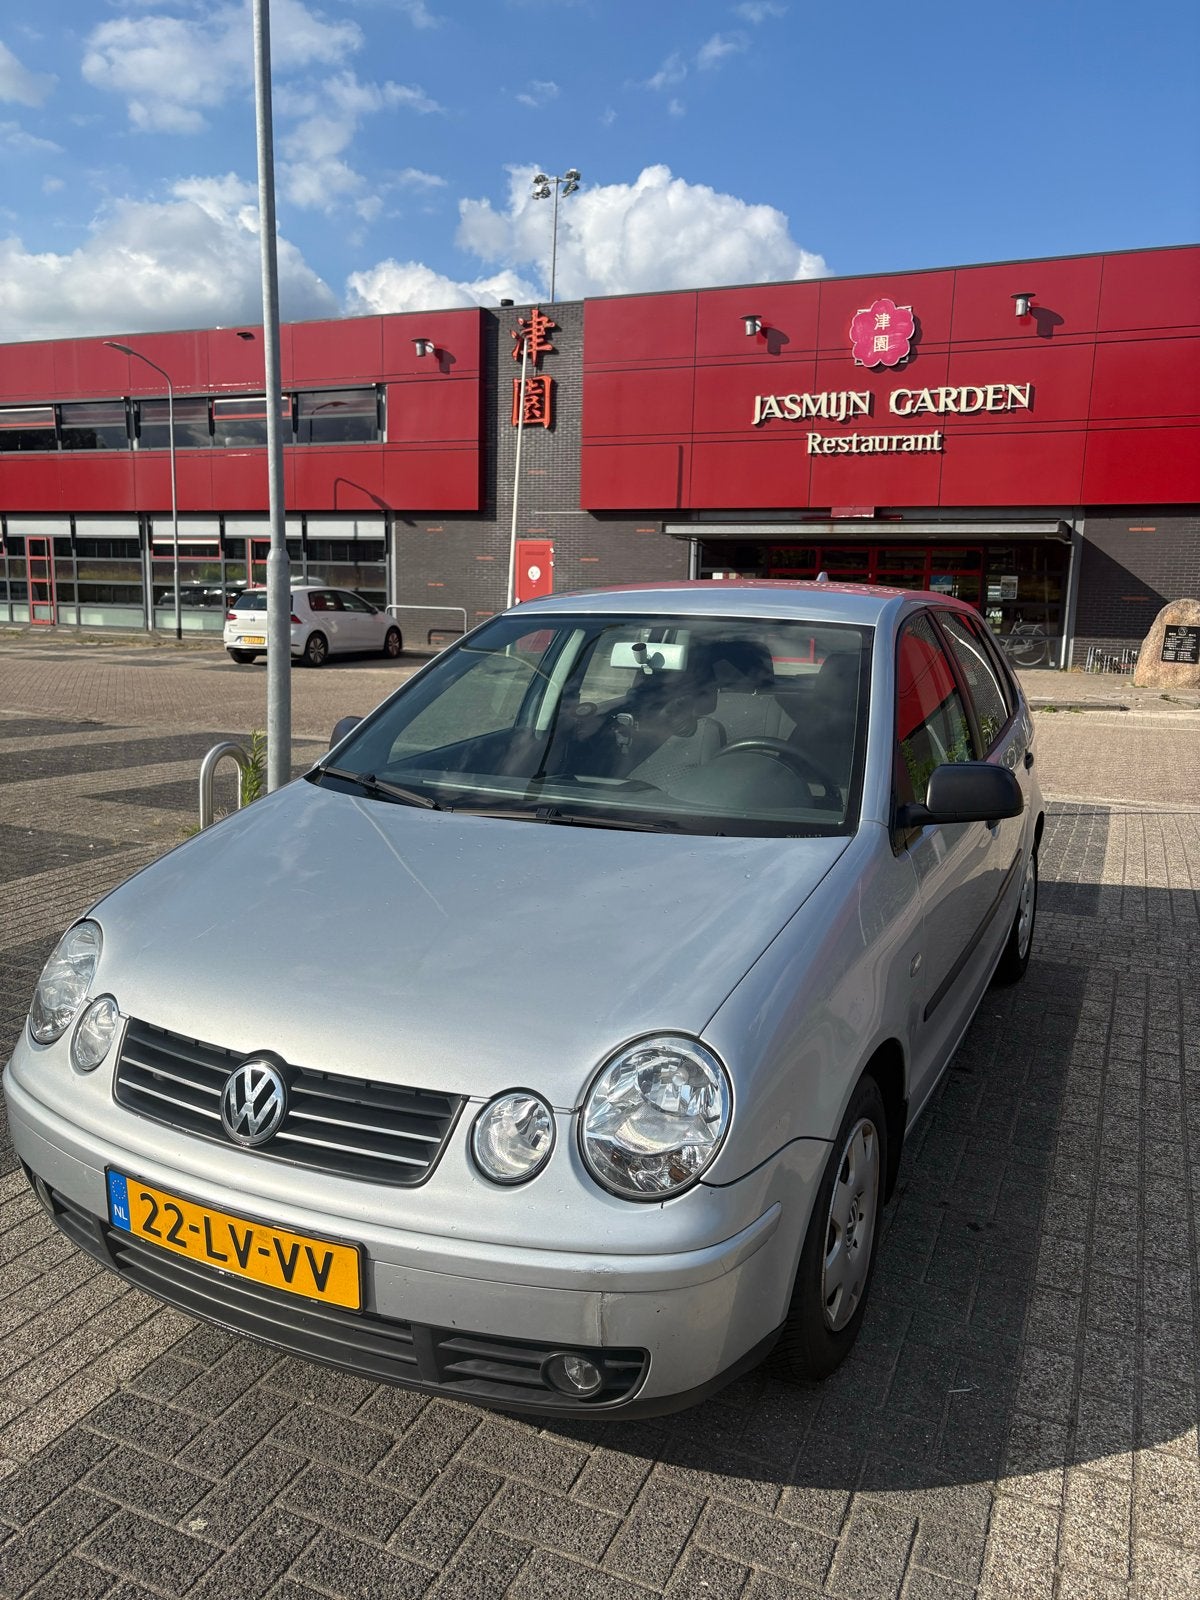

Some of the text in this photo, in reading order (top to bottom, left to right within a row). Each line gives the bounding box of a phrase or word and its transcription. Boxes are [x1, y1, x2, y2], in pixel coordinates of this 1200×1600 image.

[873, 312, 891, 353] 津園
[510, 309, 556, 429] 津園
[751, 382, 1031, 425] JASMIJN GARDEN
[805, 430, 942, 454] Restaurant
[222, 1061, 286, 1144] VW
[113, 1203, 128, 1222] NL
[140, 1192, 334, 1293] 22-LV-VV
